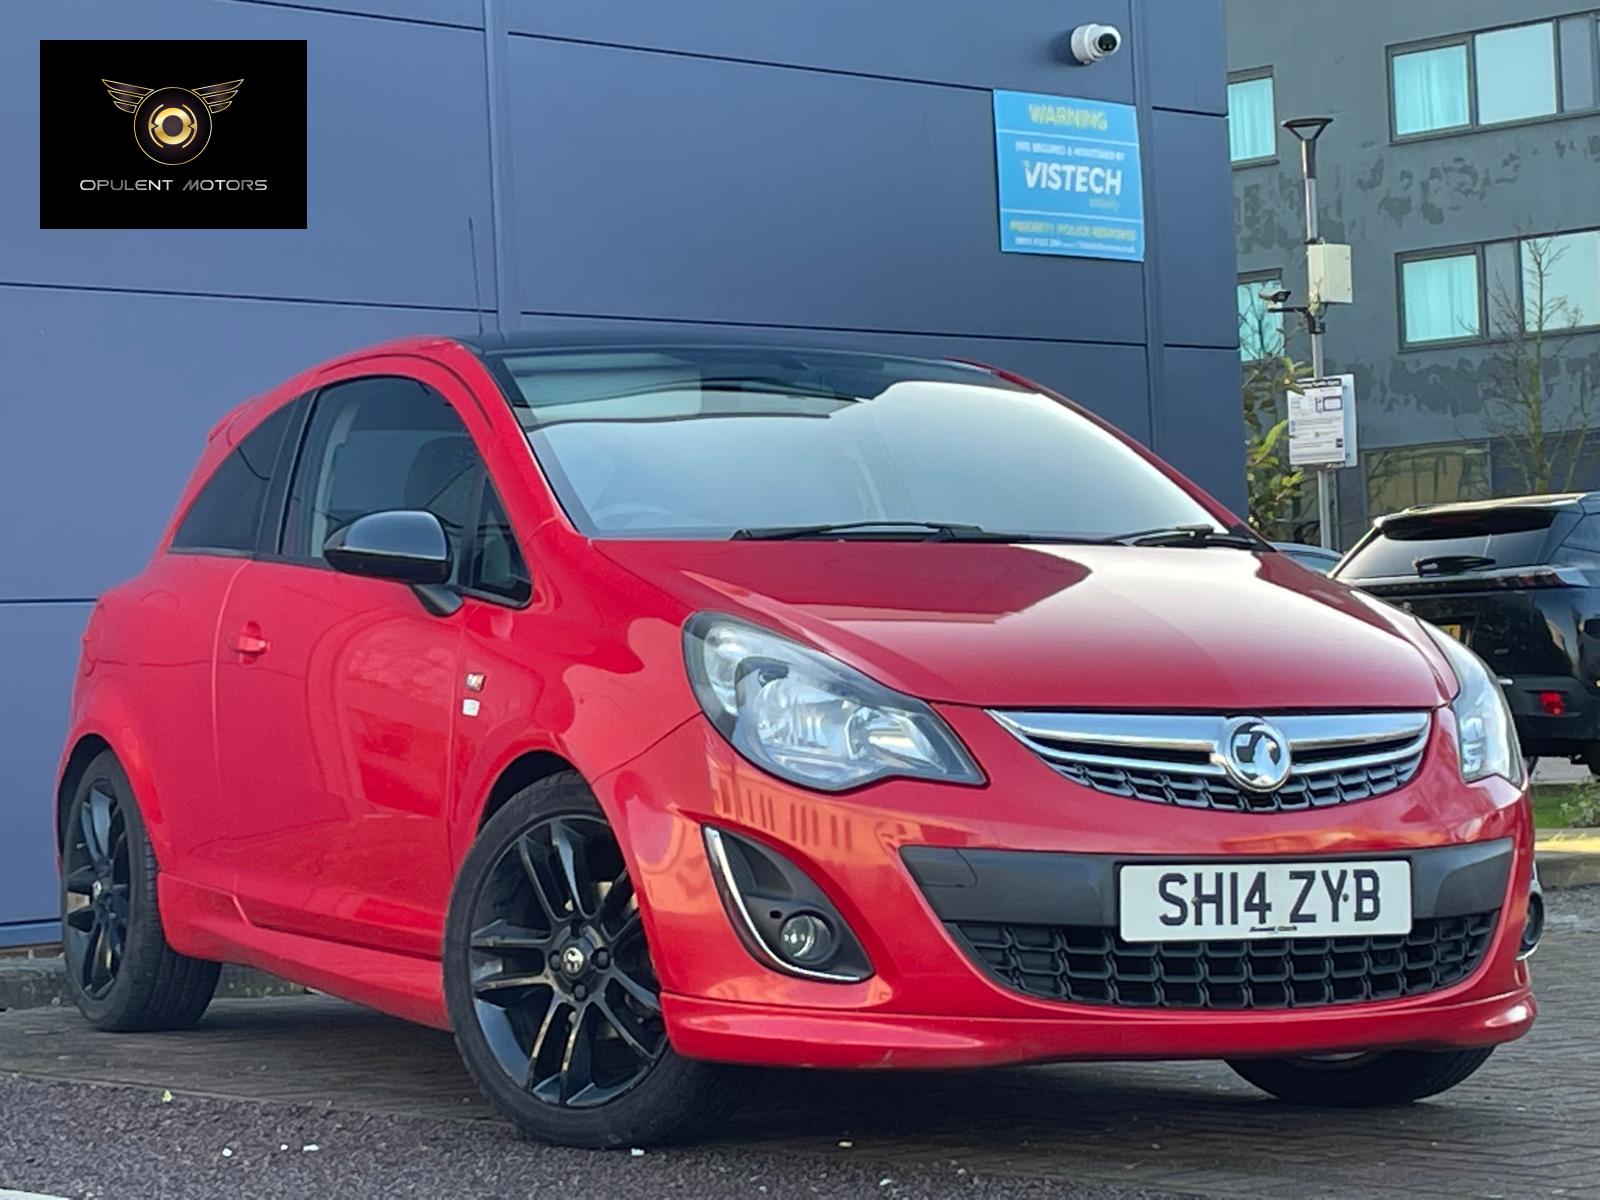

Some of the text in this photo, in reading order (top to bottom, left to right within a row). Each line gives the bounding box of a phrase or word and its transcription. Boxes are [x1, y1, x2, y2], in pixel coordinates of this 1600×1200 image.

[1028, 104, 1108, 130] WARNING
[1023, 160, 1123, 196] VISTECH
[1158, 869, 1382, 926] SH14 ZYB
